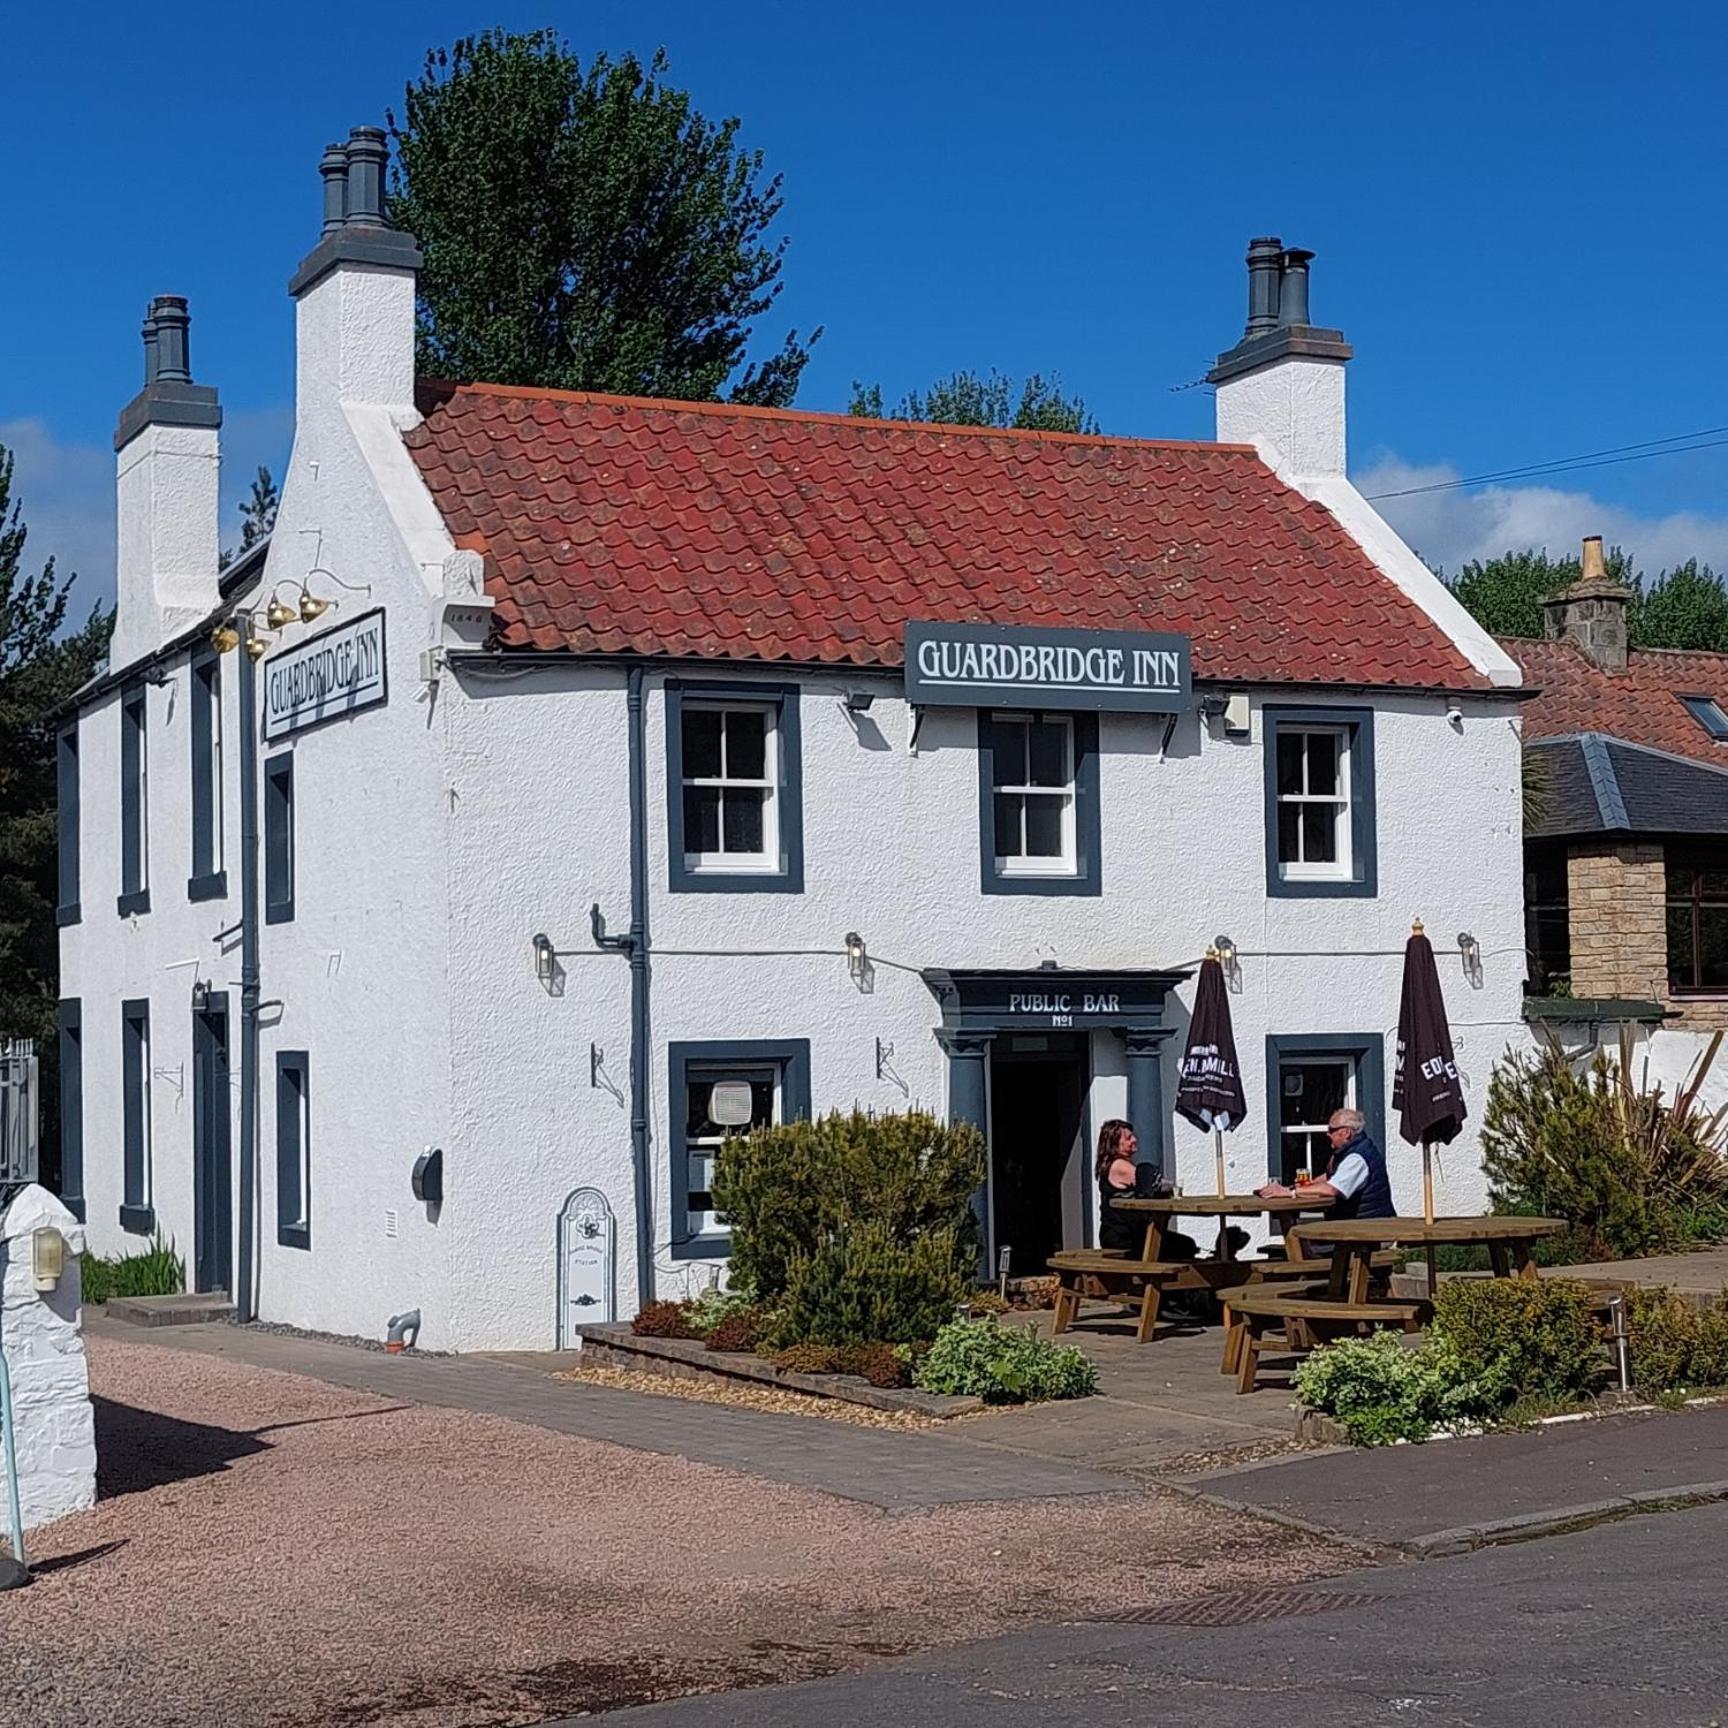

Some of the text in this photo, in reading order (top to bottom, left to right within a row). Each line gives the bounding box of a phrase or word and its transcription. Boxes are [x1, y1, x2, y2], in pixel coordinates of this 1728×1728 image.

[270, 627, 379, 715] GUARDBRIDGE INN
[918, 640, 1181, 686] GUARDBRIDGE INN
[1009, 993, 1120, 1012] PUBLIC BAR
